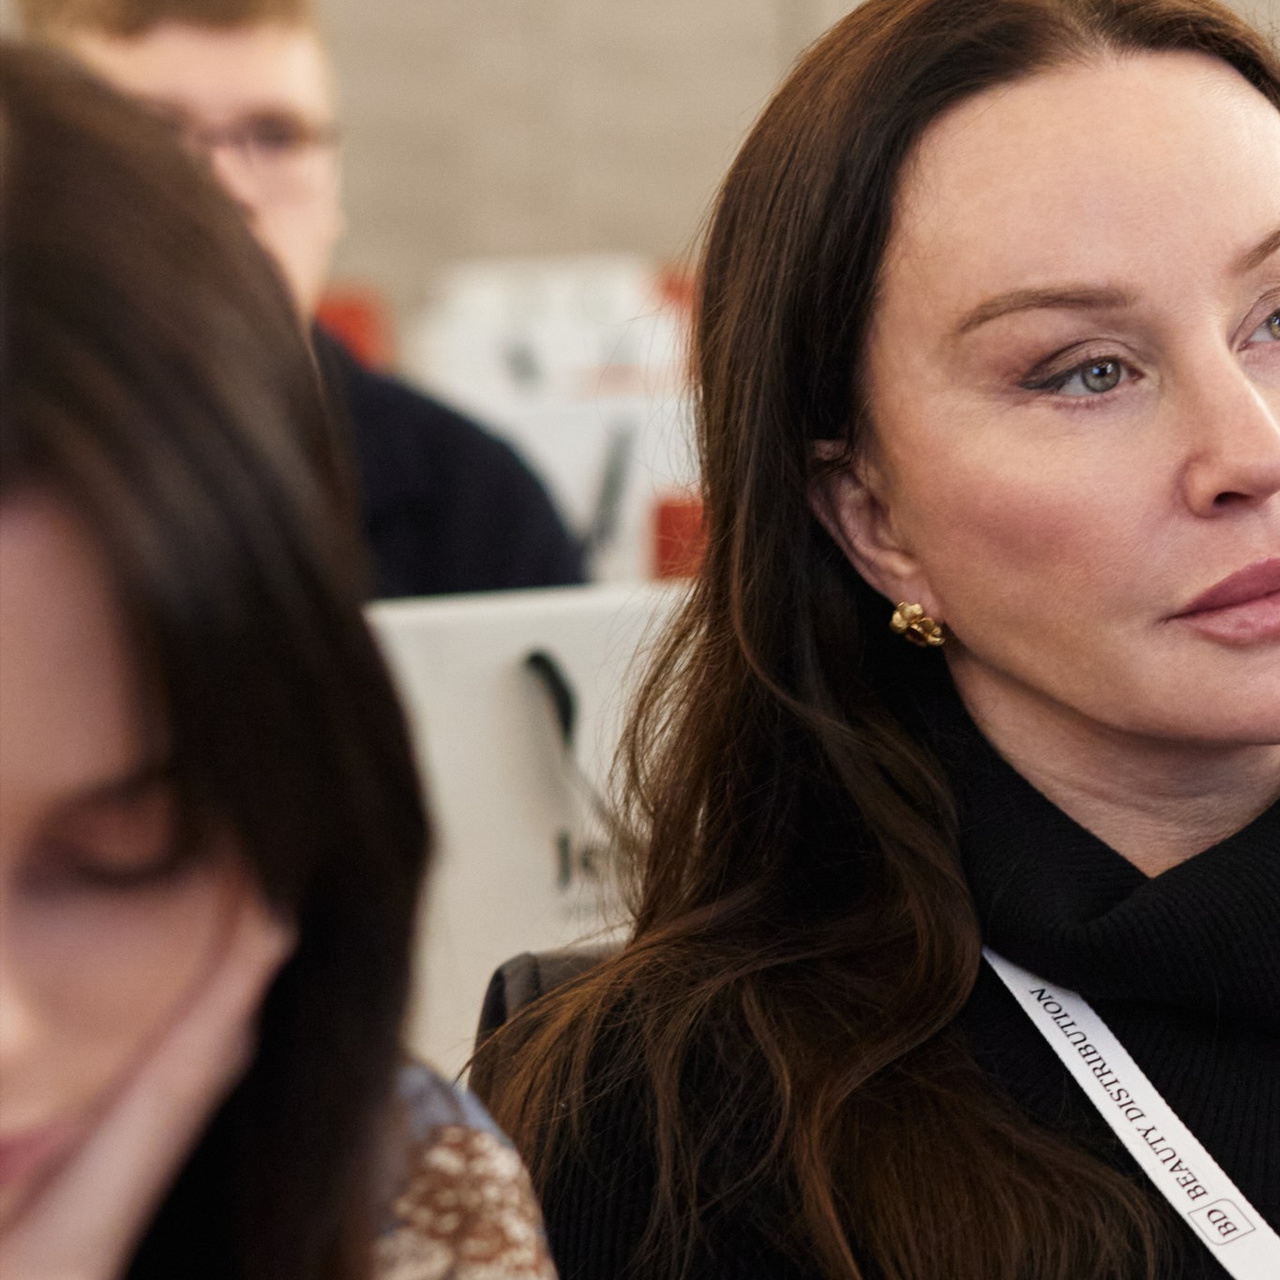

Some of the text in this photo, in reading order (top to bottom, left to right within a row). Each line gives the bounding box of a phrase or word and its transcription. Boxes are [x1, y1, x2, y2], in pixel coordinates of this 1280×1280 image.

[1029, 988, 1238, 1237] BD BEAUTY DISTRIBUTION
